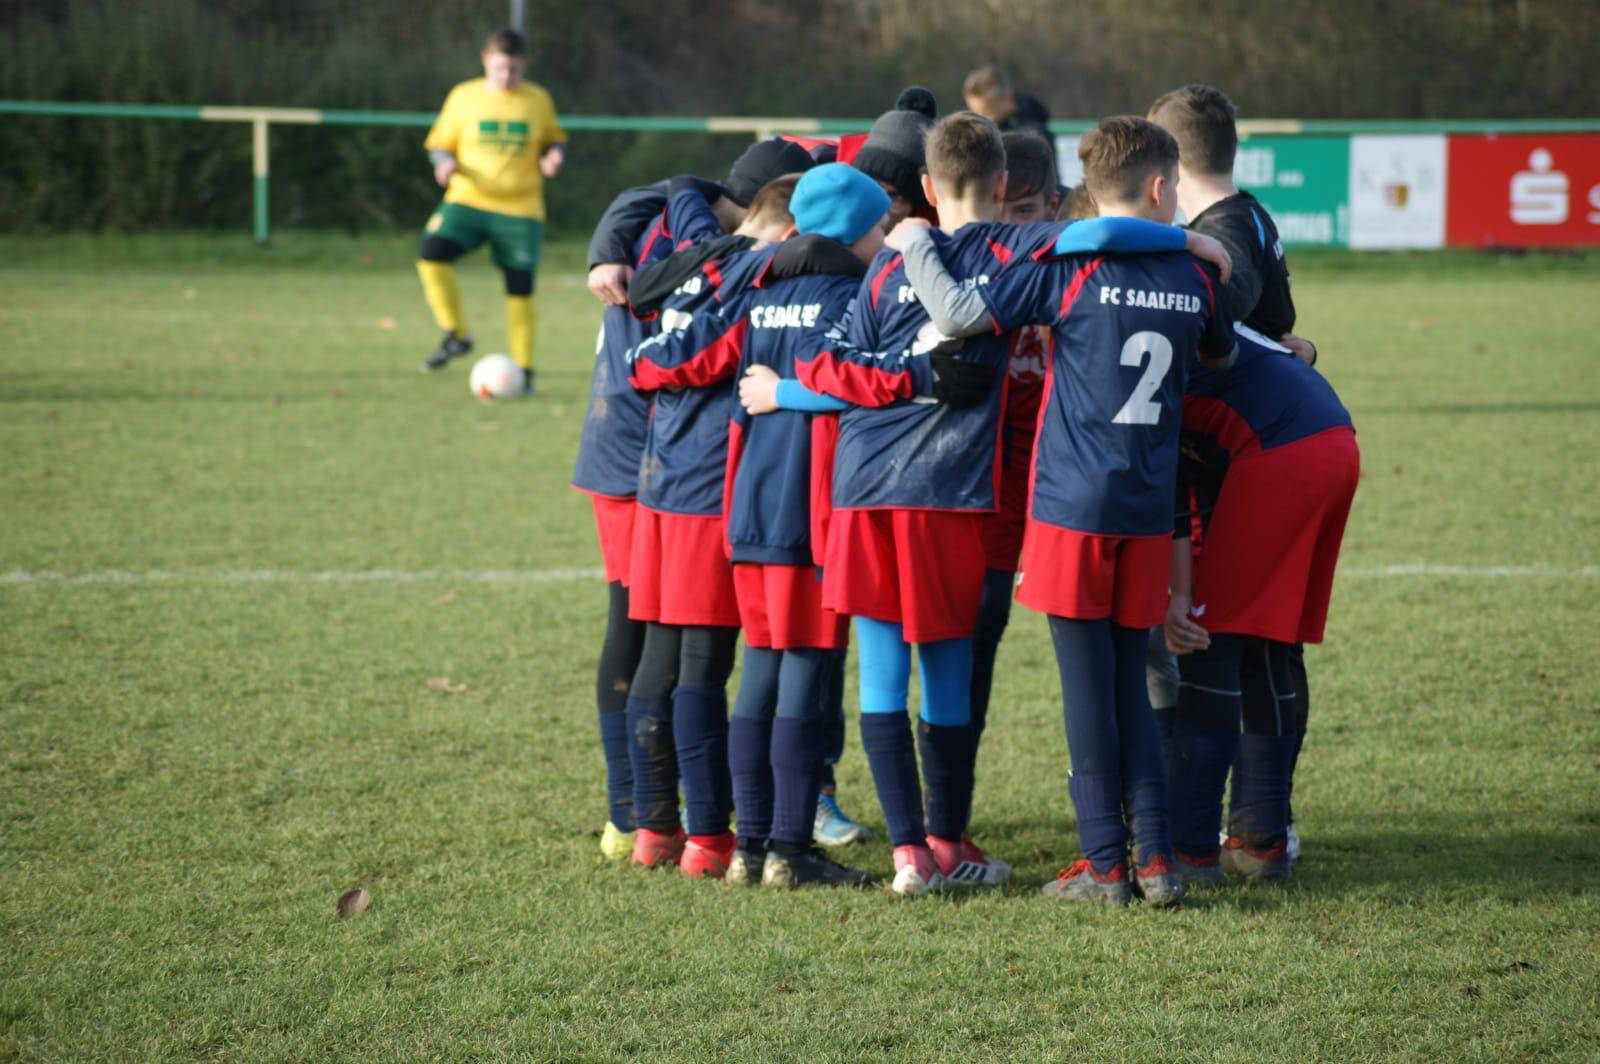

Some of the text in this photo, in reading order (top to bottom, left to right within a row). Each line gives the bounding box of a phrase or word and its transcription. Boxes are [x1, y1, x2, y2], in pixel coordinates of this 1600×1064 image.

[1100, 286, 1201, 313] FC SAALFELD
[1111, 330, 1173, 425] 2
